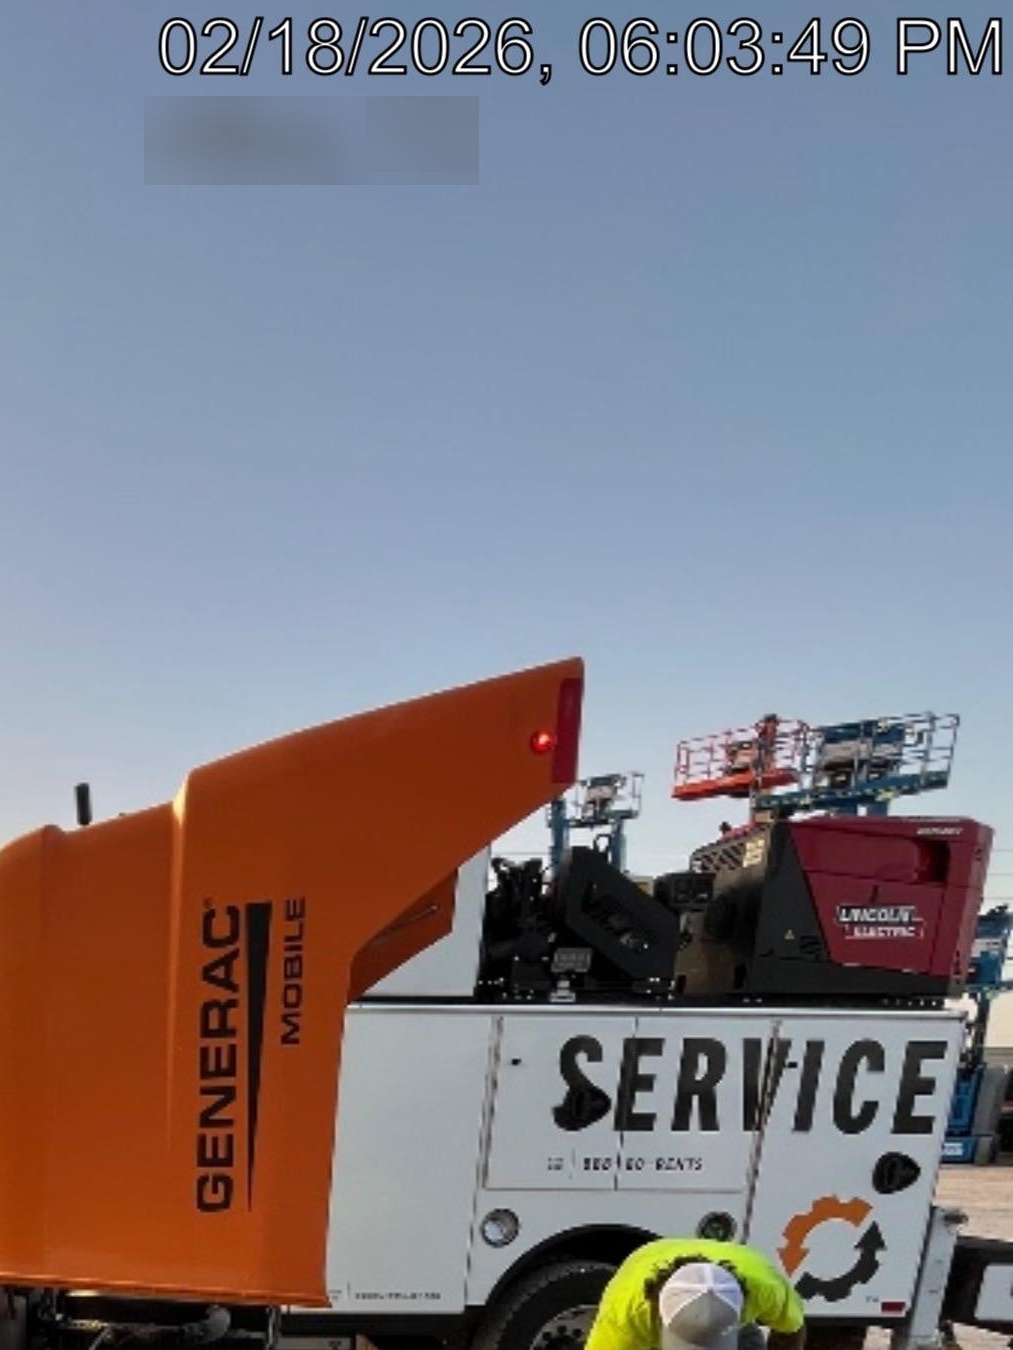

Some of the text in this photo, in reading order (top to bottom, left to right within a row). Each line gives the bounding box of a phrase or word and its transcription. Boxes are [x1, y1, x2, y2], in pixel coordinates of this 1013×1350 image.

[281, 897, 305, 1045] MOBILE
[196, 905, 240, 1213] GENERAC
[551, 1033, 948, 1136] SERVICE
